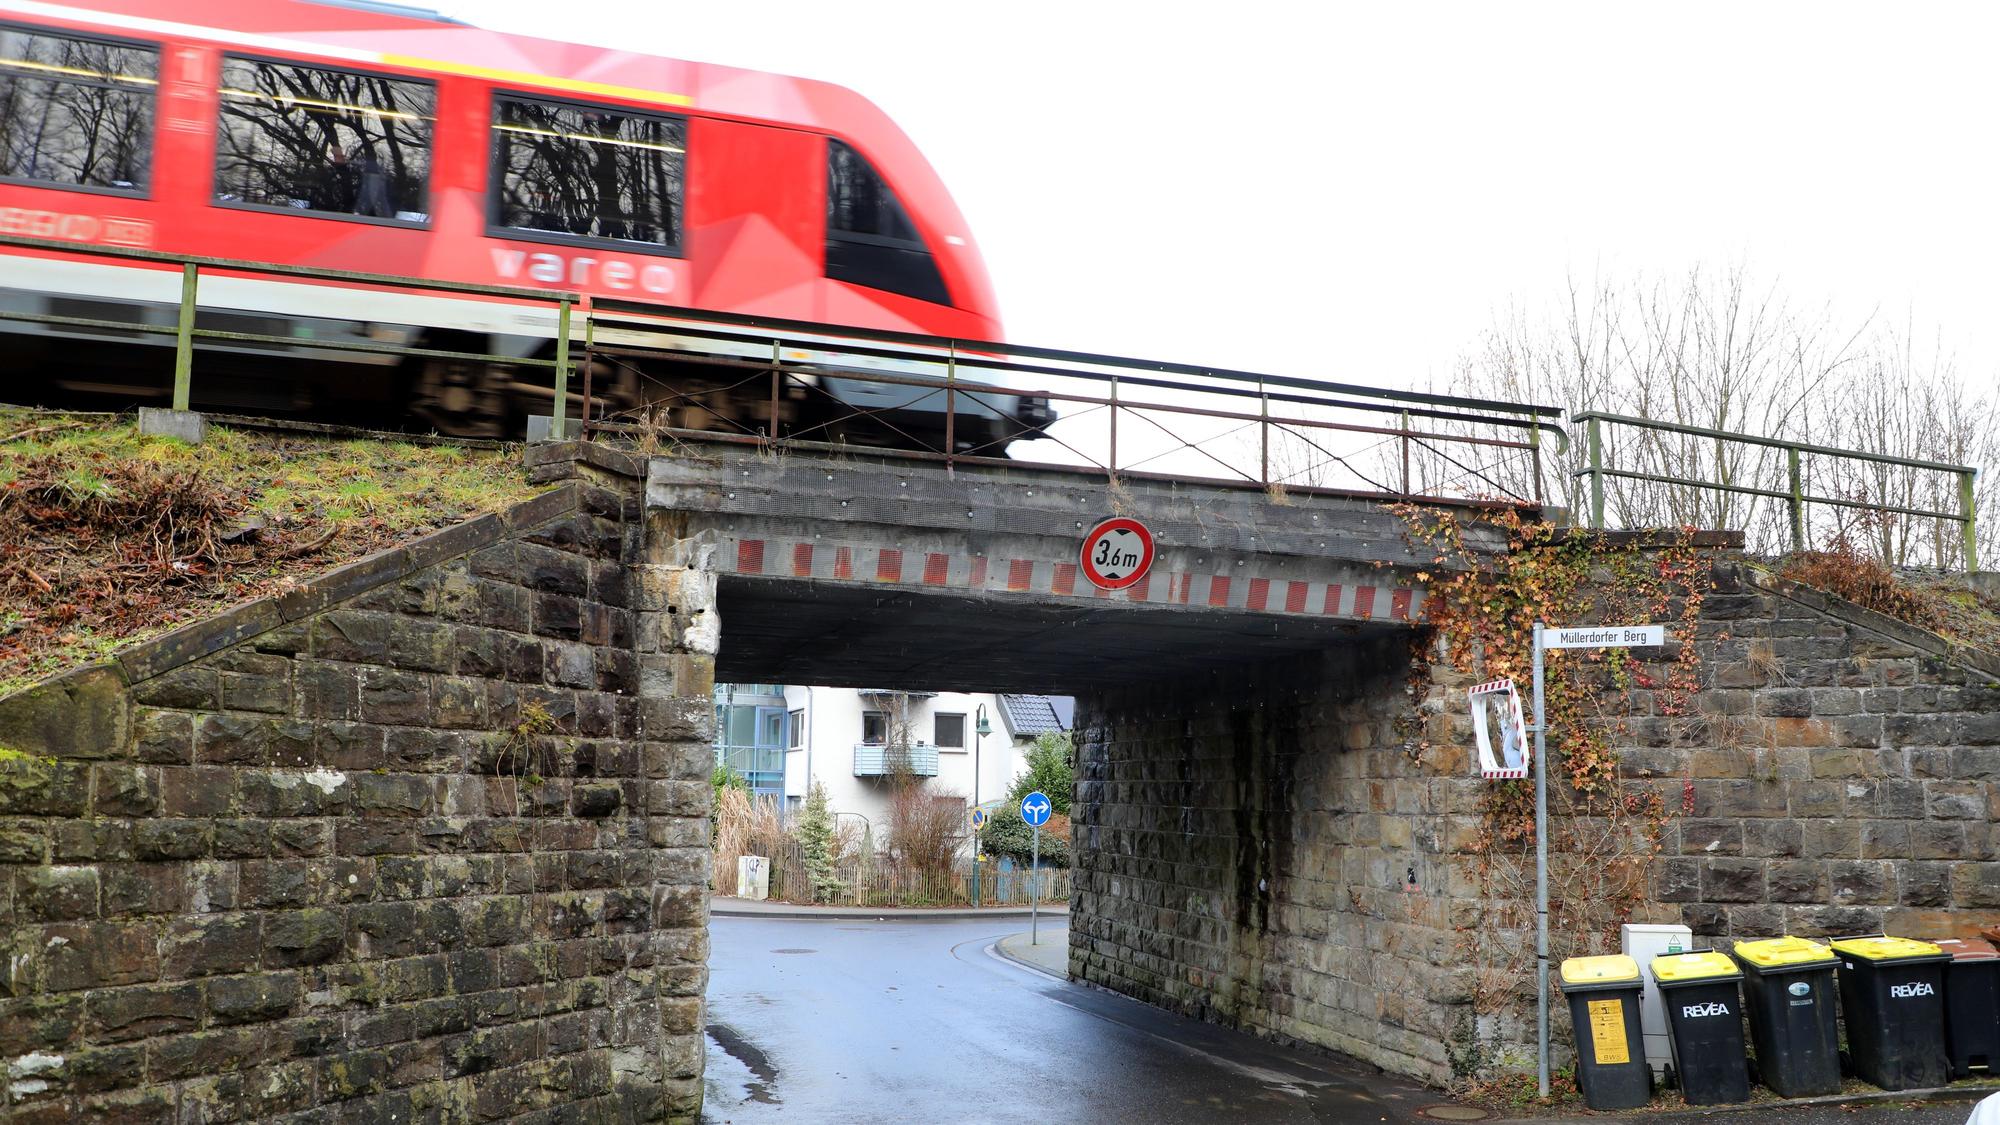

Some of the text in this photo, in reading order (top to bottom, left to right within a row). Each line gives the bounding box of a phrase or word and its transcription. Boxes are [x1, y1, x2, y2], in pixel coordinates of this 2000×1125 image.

[490, 248, 676, 294] vareo
[1560, 630, 1647, 645] Müllerdorfer Berg
[1890, 981, 1935, 998] REVEA
[1682, 1001, 1730, 1018] REVEA
